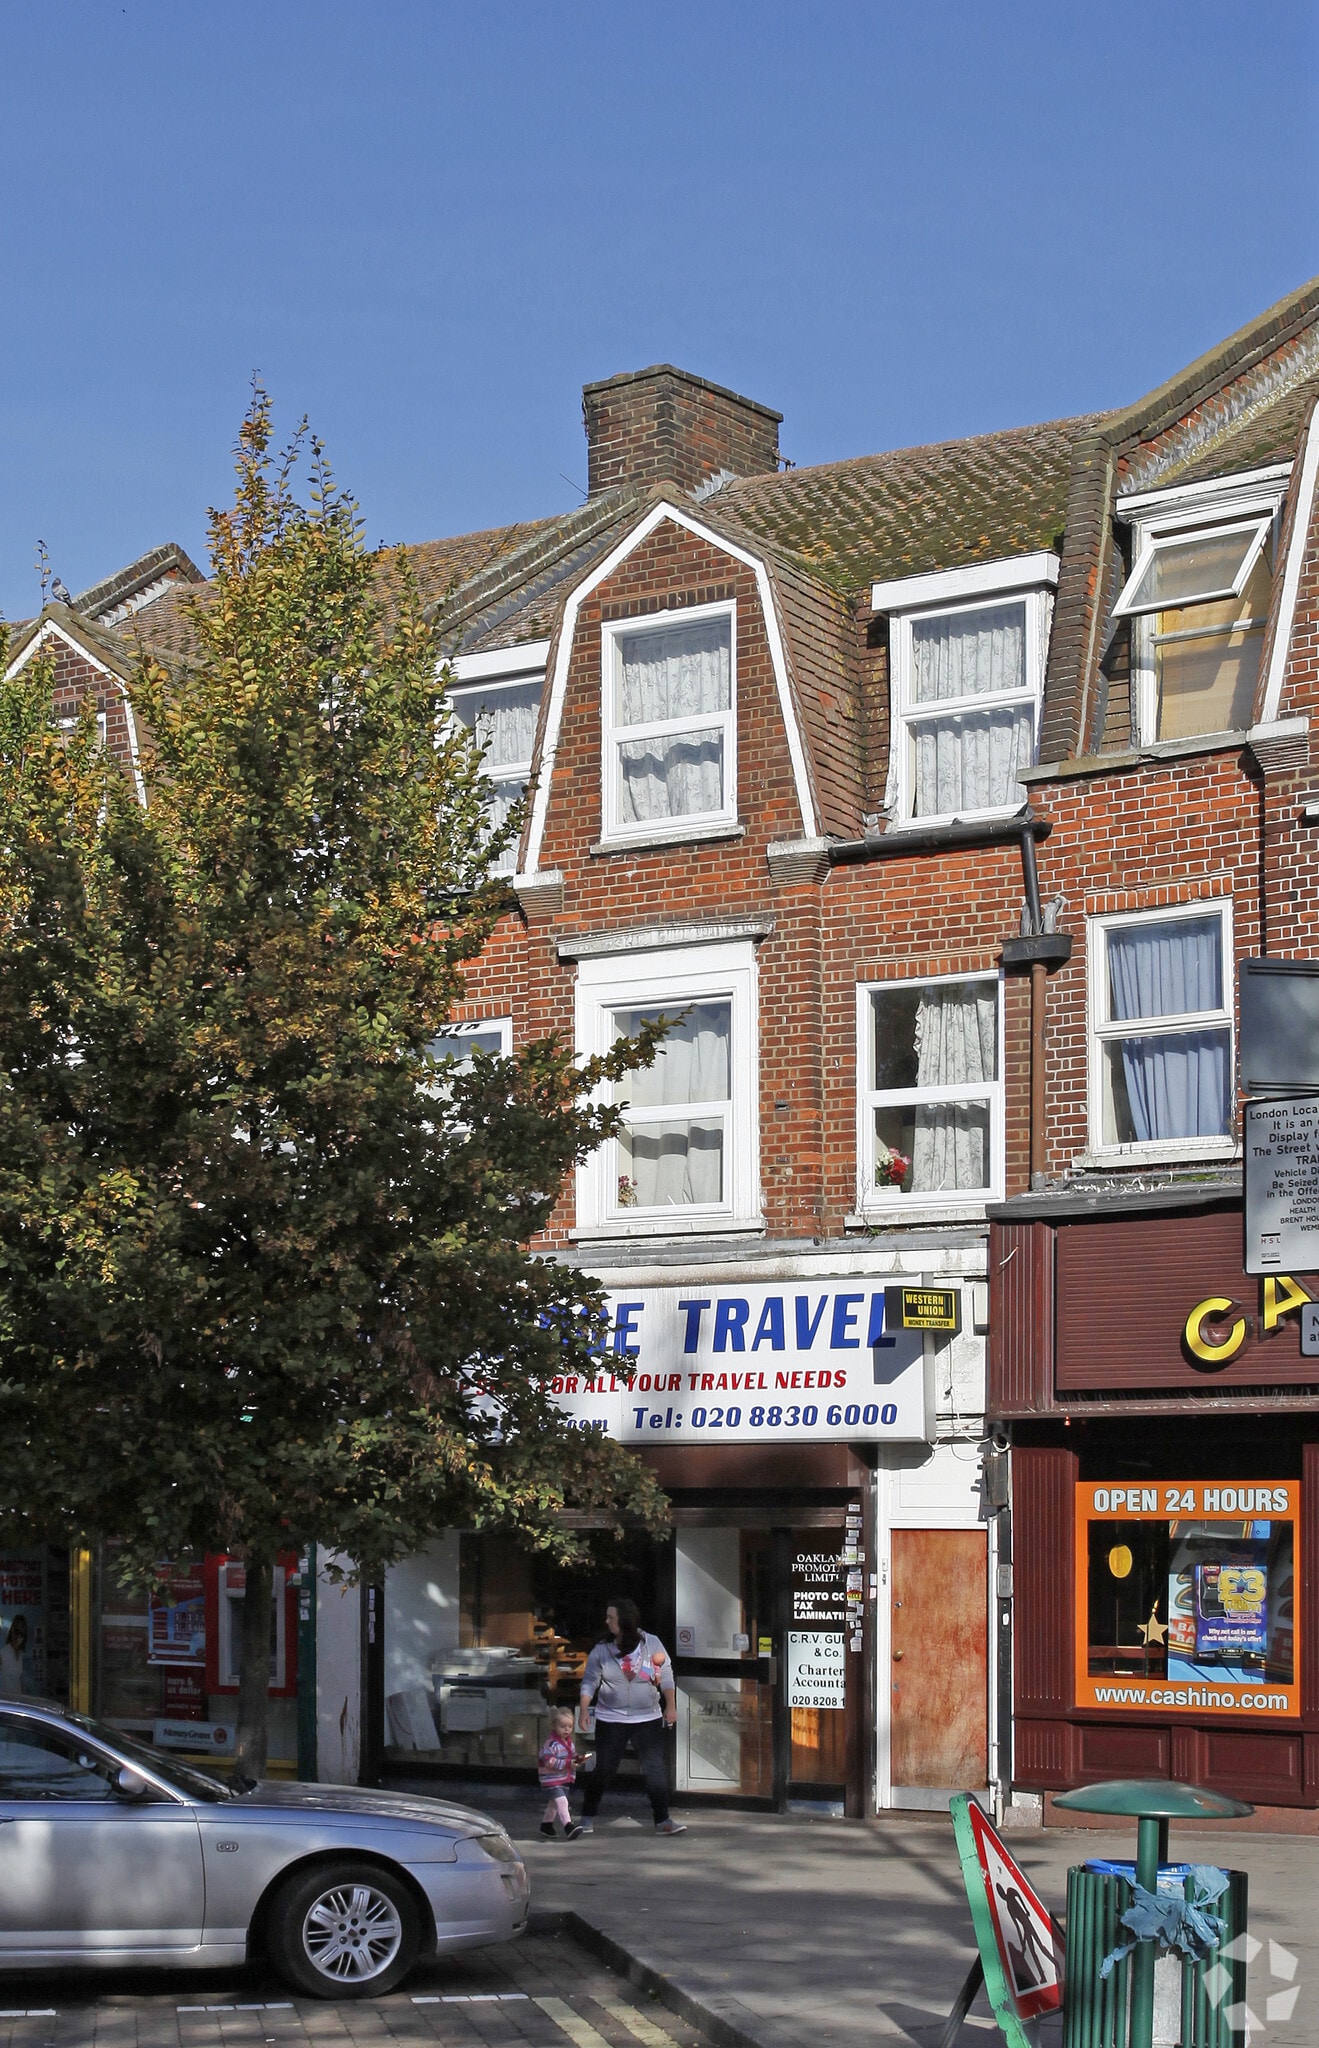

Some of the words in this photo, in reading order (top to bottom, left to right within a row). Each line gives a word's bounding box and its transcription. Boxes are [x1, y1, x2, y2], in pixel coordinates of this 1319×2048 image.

[1250, 1108, 1288, 1120] London
[1273, 1120, 1281, 1130] It
[1286, 1119, 1295, 1129] is
[1300, 1119, 1313, 1128] an
[1269, 1131, 1309, 1143] Display
[1253, 1146, 1272, 1157] The
[1277, 1143, 1311, 1155] Street
[1295, 1154, 1319, 1165] TRA
[1274, 1167, 1307, 1178] Vehicle
[1272, 1180, 1284, 1189] Be
[1288, 1177, 1318, 1188] Seized
[1267, 1190, 1275, 1199] in
[1279, 1188, 1294, 1197] the
[1298, 1187, 1319, 1196] Offe
[1292, 1197, 1319, 1205] LONDO
[1289, 1206, 1316, 1214] HEALTH
[1280, 1216, 1304, 1225] BRENT
[905, 1294, 944, 1305] WESTERN
[917, 1305, 944, 1316] UNION
[678, 1293, 897, 1354] TRAVEL
[540, 1376, 579, 1395] OR
[583, 1373, 620, 1394] ALL
[627, 1373, 682, 1392] YOUR
[688, 1371, 768, 1391] TRAVEL
[775, 1369, 848, 1390] NEEDS
[633, 1407, 684, 1429] Tel:
[691, 1406, 742, 1428] 020
[749, 1405, 819, 1427] 8830
[826, 1403, 898, 1426] 6000
[1093, 1488, 1157, 1512] OPEN
[1165, 1488, 1196, 1512] 24
[1203, 1488, 1289, 1513] HOURS
[792, 1563, 841, 1572] PROMOT
[2, 1590, 41, 1605] HERE
[794, 1592, 829, 1601] PHOTO
[794, 1601, 813, 1610] FAX
[794, 1611, 845, 1620] LAMINATI
[814, 1647, 822, 1657] &
[824, 1647, 842, 1658] Co.
[179, 1686, 201, 1695] dollar
[792, 1695, 811, 1706] 020
[812, 1696, 838, 1706] 8208
[1094, 1686, 1289, 1710] www.cashino.com
